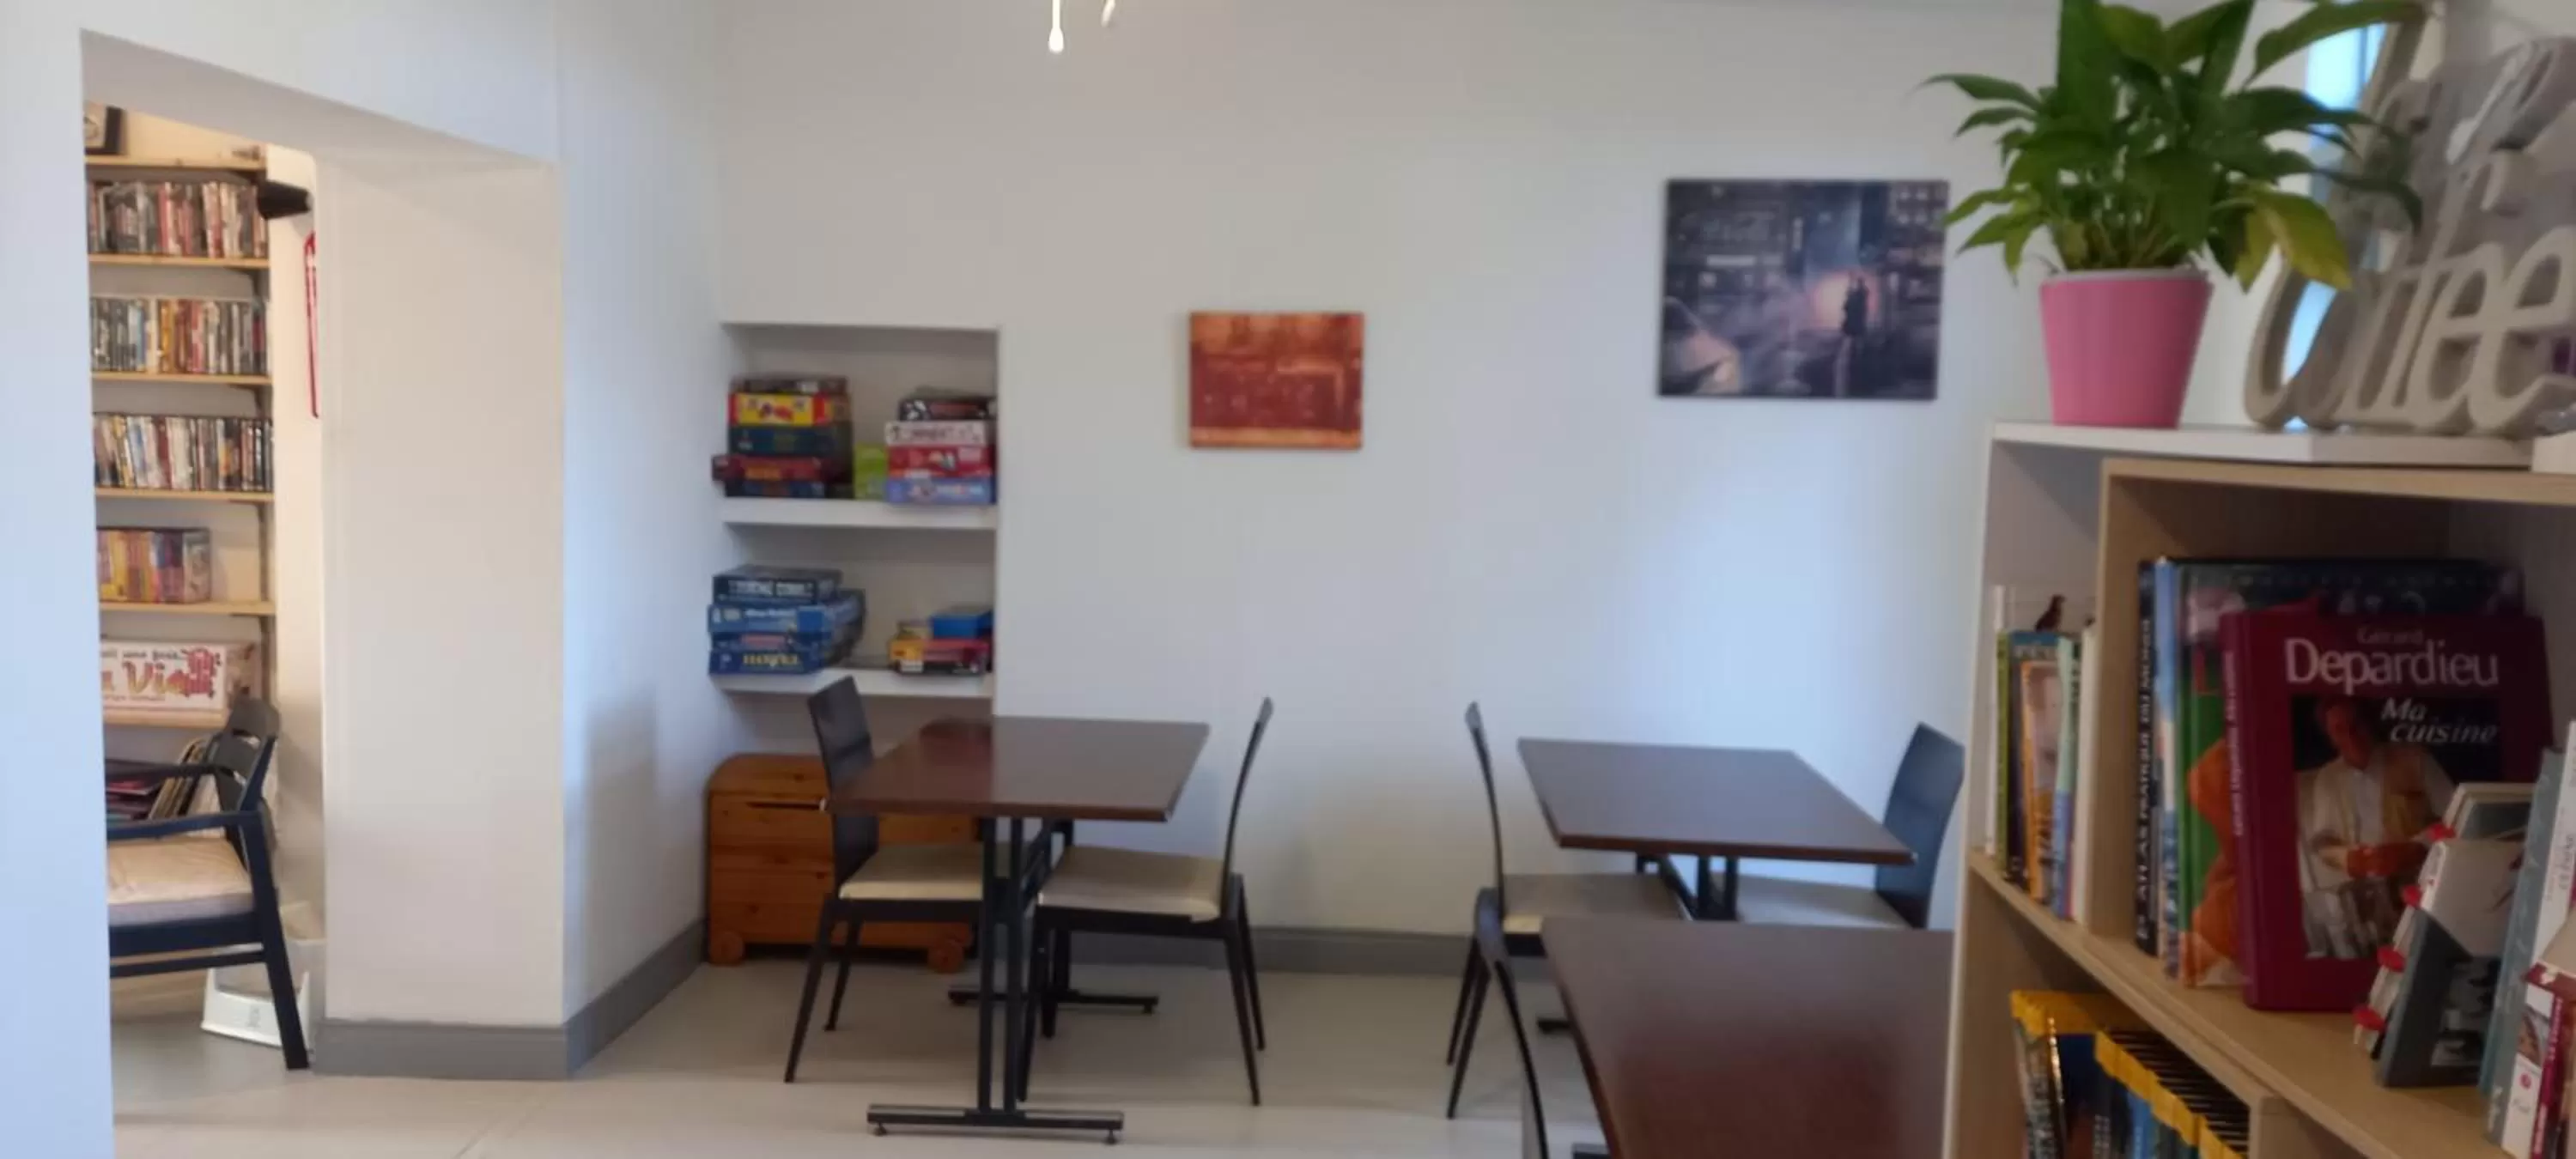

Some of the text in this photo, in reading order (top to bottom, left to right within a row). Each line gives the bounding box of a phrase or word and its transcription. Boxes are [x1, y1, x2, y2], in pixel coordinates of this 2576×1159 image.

[2284, 636, 2500, 696] Depardieu
[2379, 697, 2427, 721] Ma
[2389, 719, 2498, 744] cuisine
